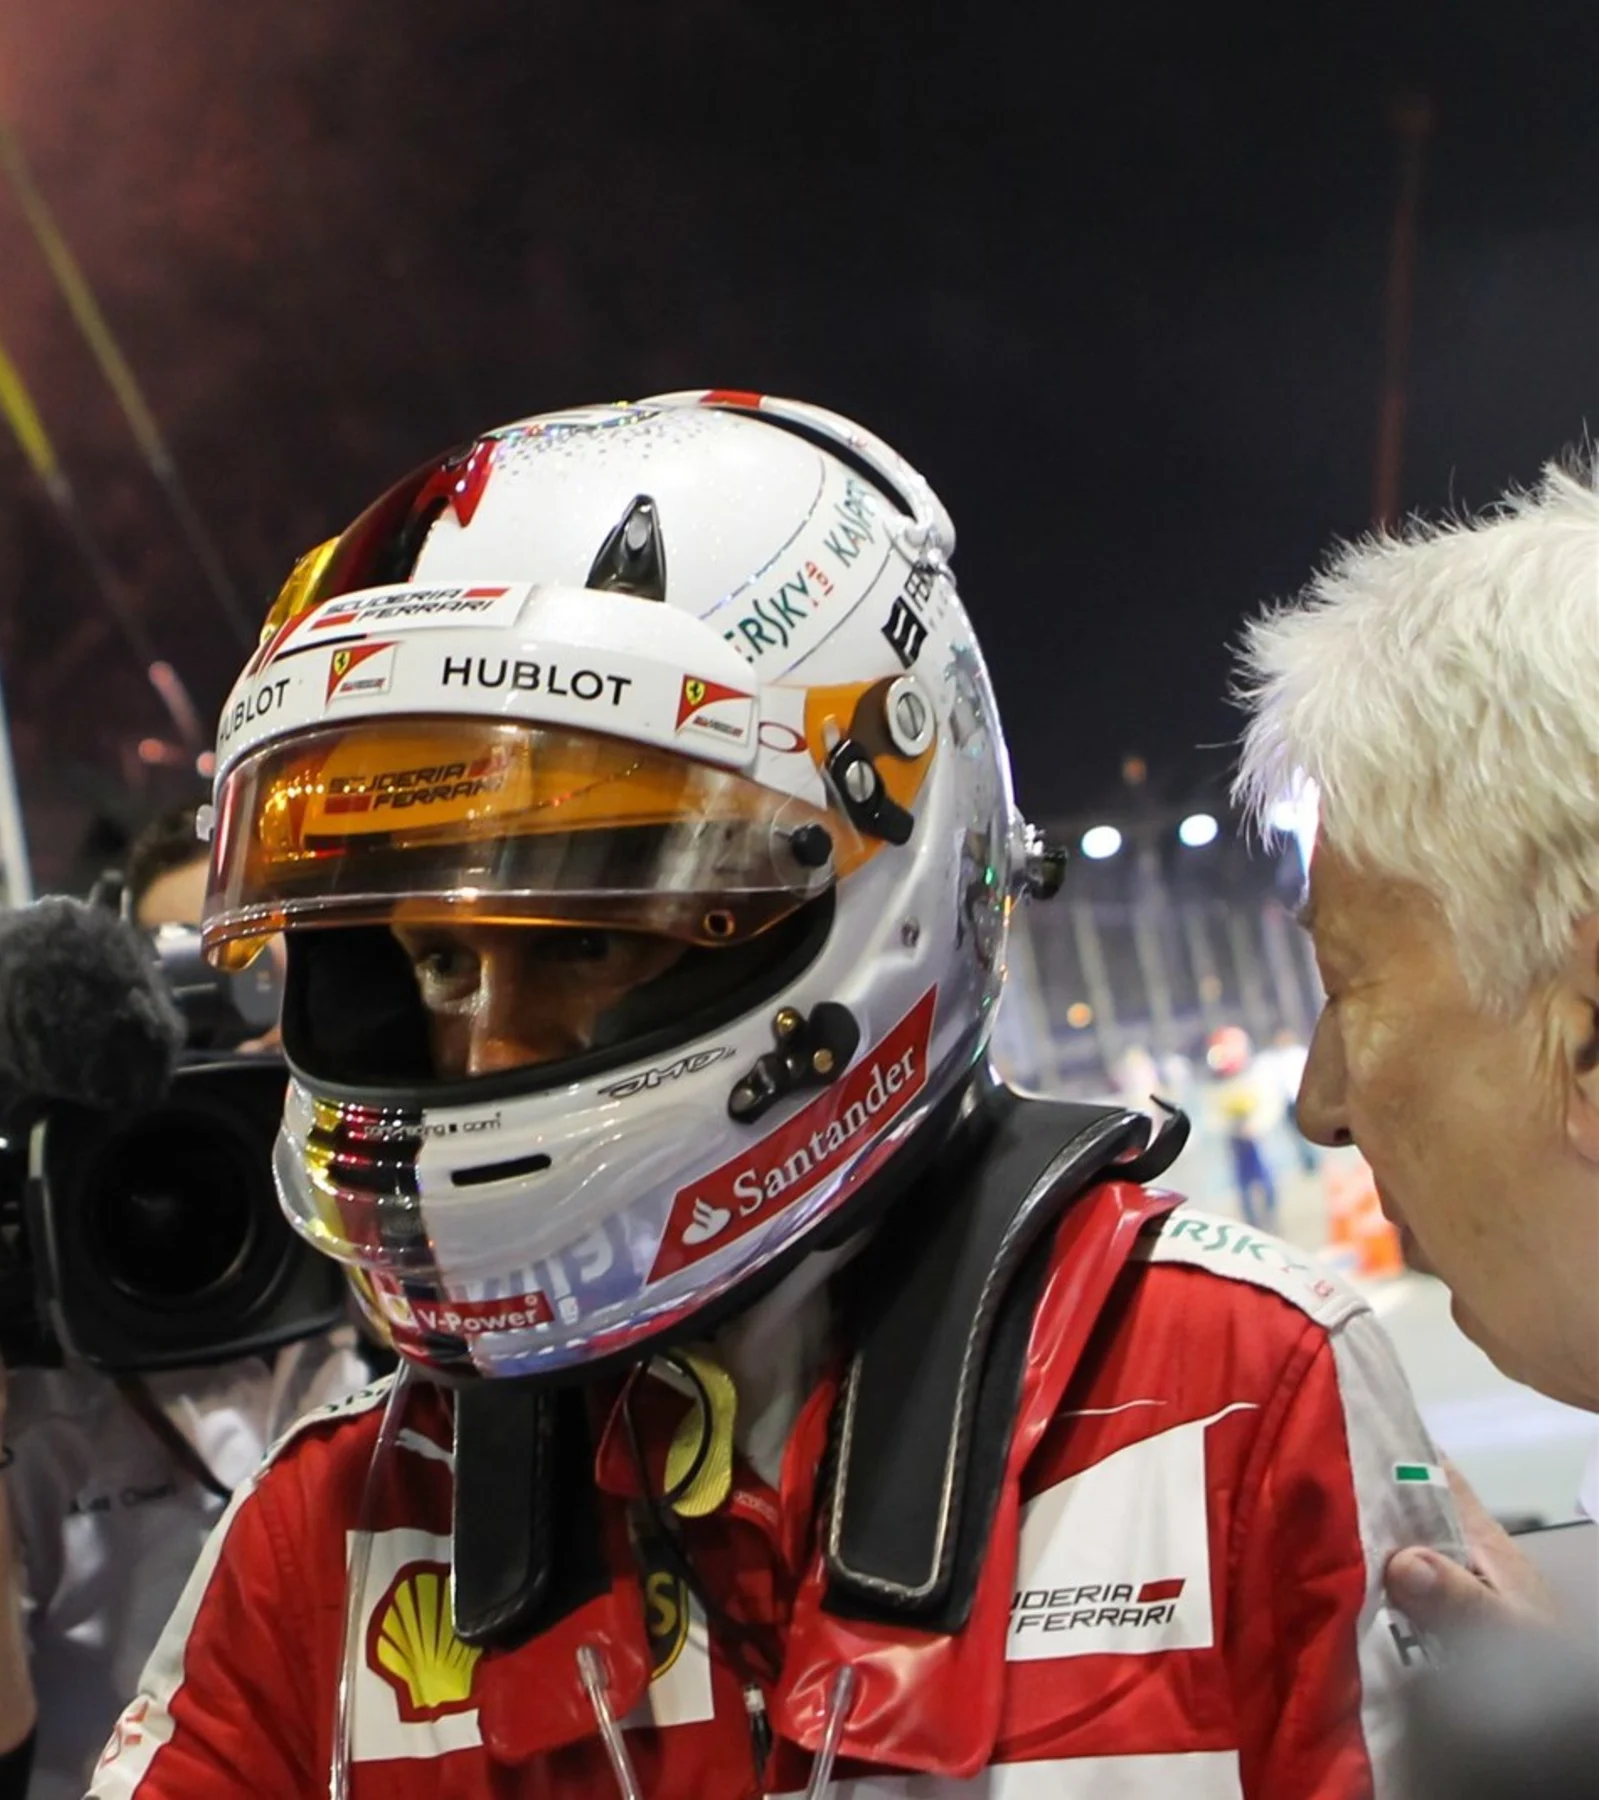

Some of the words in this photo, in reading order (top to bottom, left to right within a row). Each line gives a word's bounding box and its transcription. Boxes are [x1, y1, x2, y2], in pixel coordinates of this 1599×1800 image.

[324, 588, 462, 615] SCUDERIA
[357, 600, 494, 622] FERRARI
[441, 656, 632, 706] HUBLOT
[733, 1046, 917, 1217] Santander
[1162, 1217, 1310, 1277] RSKY
[417, 1307, 538, 1334] V-Power
[1015, 1604, 1176, 1635] FERRARI
